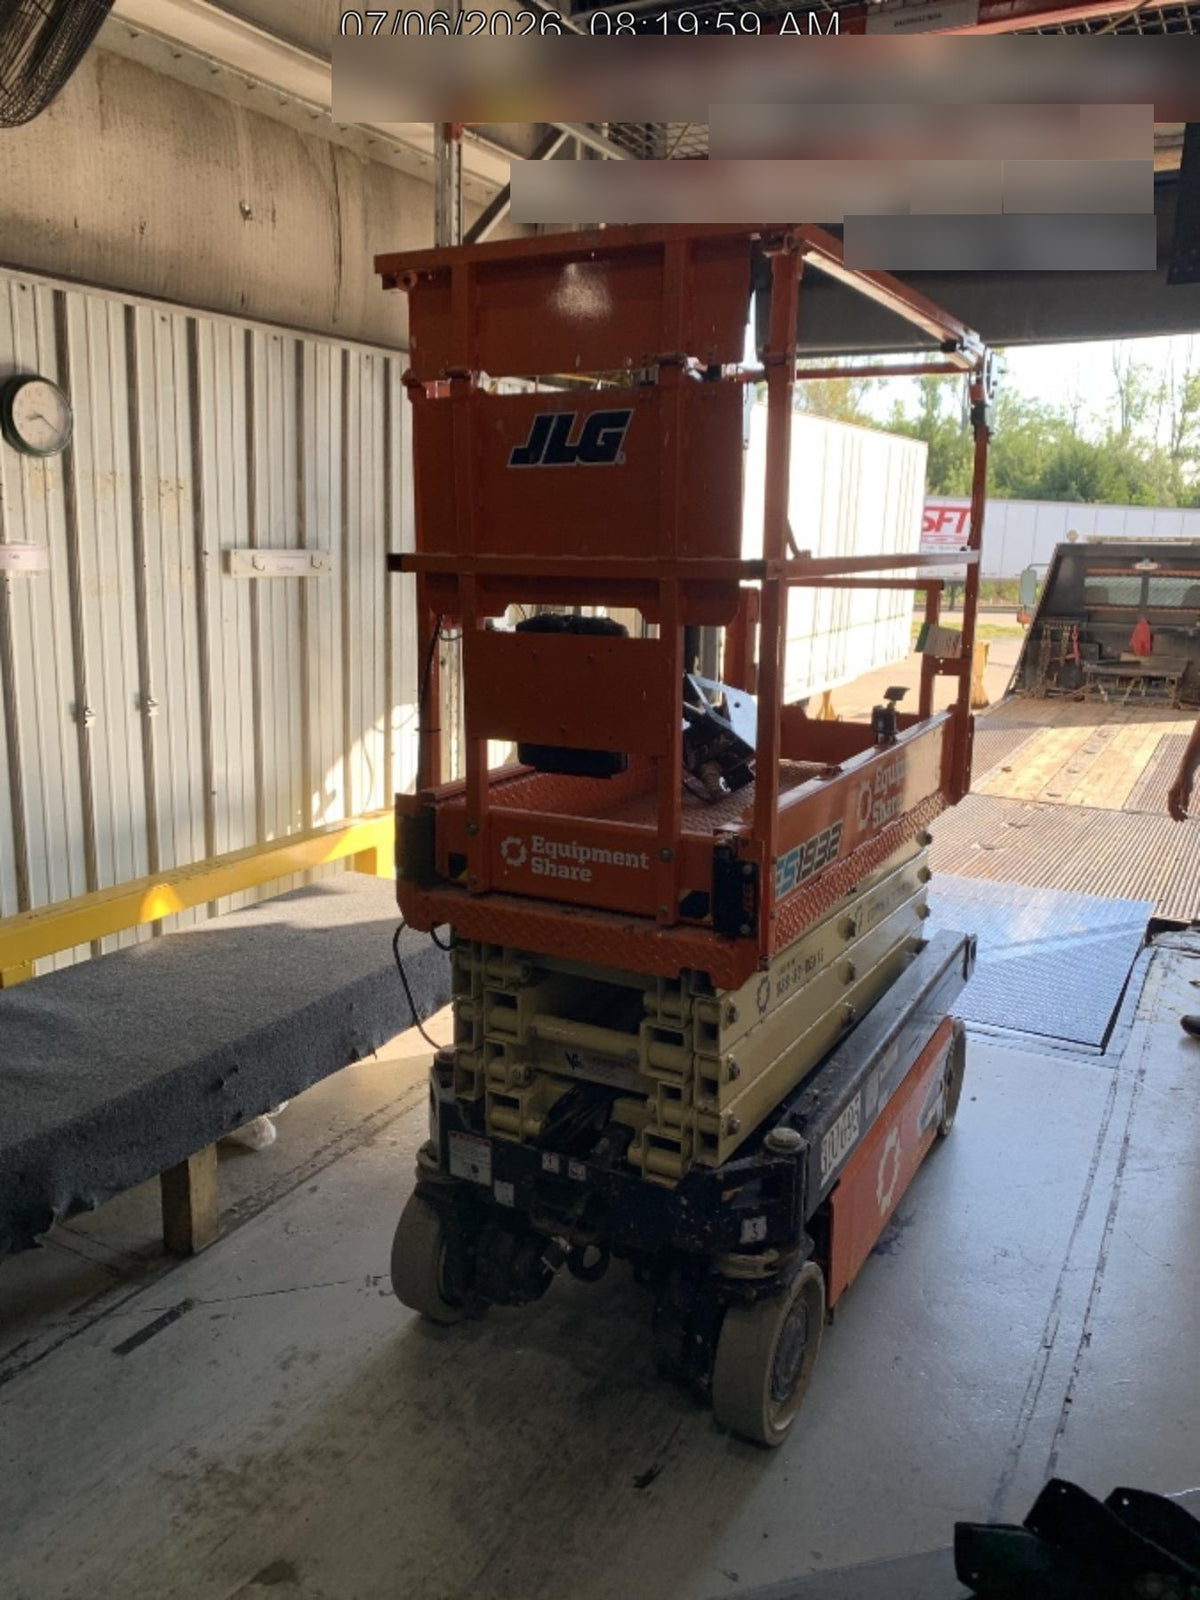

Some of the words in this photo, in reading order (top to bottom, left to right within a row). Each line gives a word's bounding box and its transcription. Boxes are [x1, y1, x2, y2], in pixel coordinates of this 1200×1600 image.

[507, 409, 634, 468] JLG
[531, 835, 650, 869] Equipment
[531, 857, 593, 882] Share
